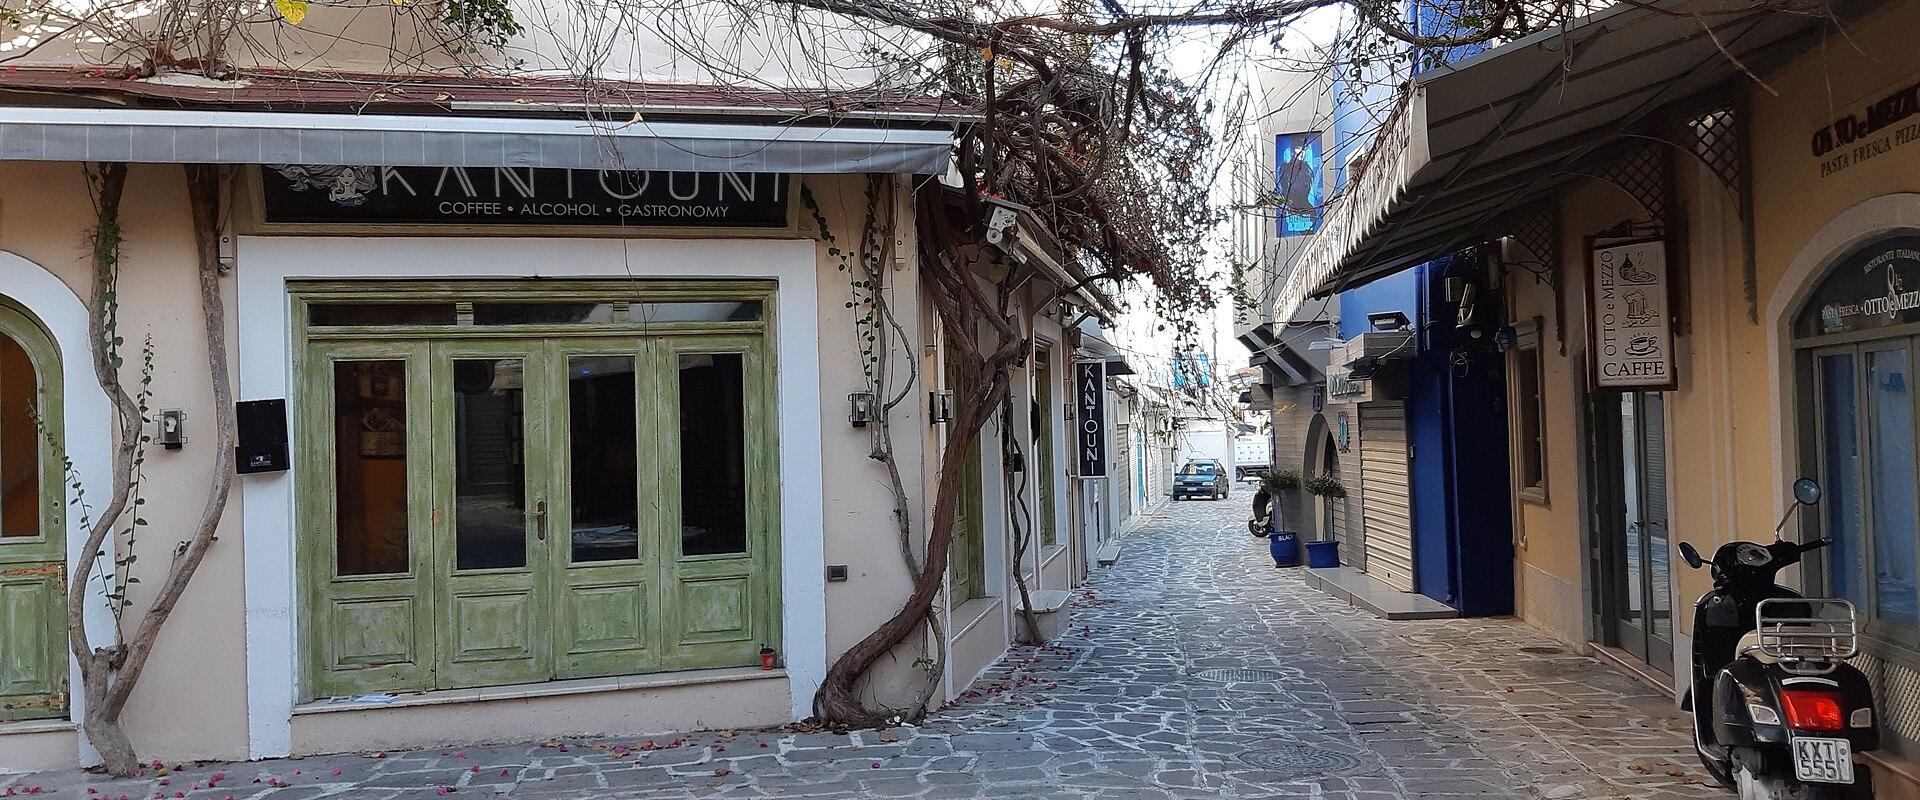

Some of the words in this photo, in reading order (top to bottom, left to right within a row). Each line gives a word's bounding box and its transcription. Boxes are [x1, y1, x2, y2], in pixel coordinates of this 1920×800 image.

[1820, 154, 1849, 178] PASTA
[1853, 136, 1891, 164] FRESCA
[439, 201, 502, 215] COFFEE
[520, 203, 600, 216] ALCOHOL
[618, 204, 729, 218] GASTRONOMY
[1601, 250, 1615, 300] MEZZO
[1605, 302, 1615, 310] e
[1863, 296, 1889, 316] OTTO
[1603, 313, 1617, 356] OTTO
[1603, 361, 1665, 377] CAFFE
[1084, 364, 1098, 475] KANTOUNI
[1797, 741, 1834, 762] KXT
[1801, 759, 1837, 779] 555
